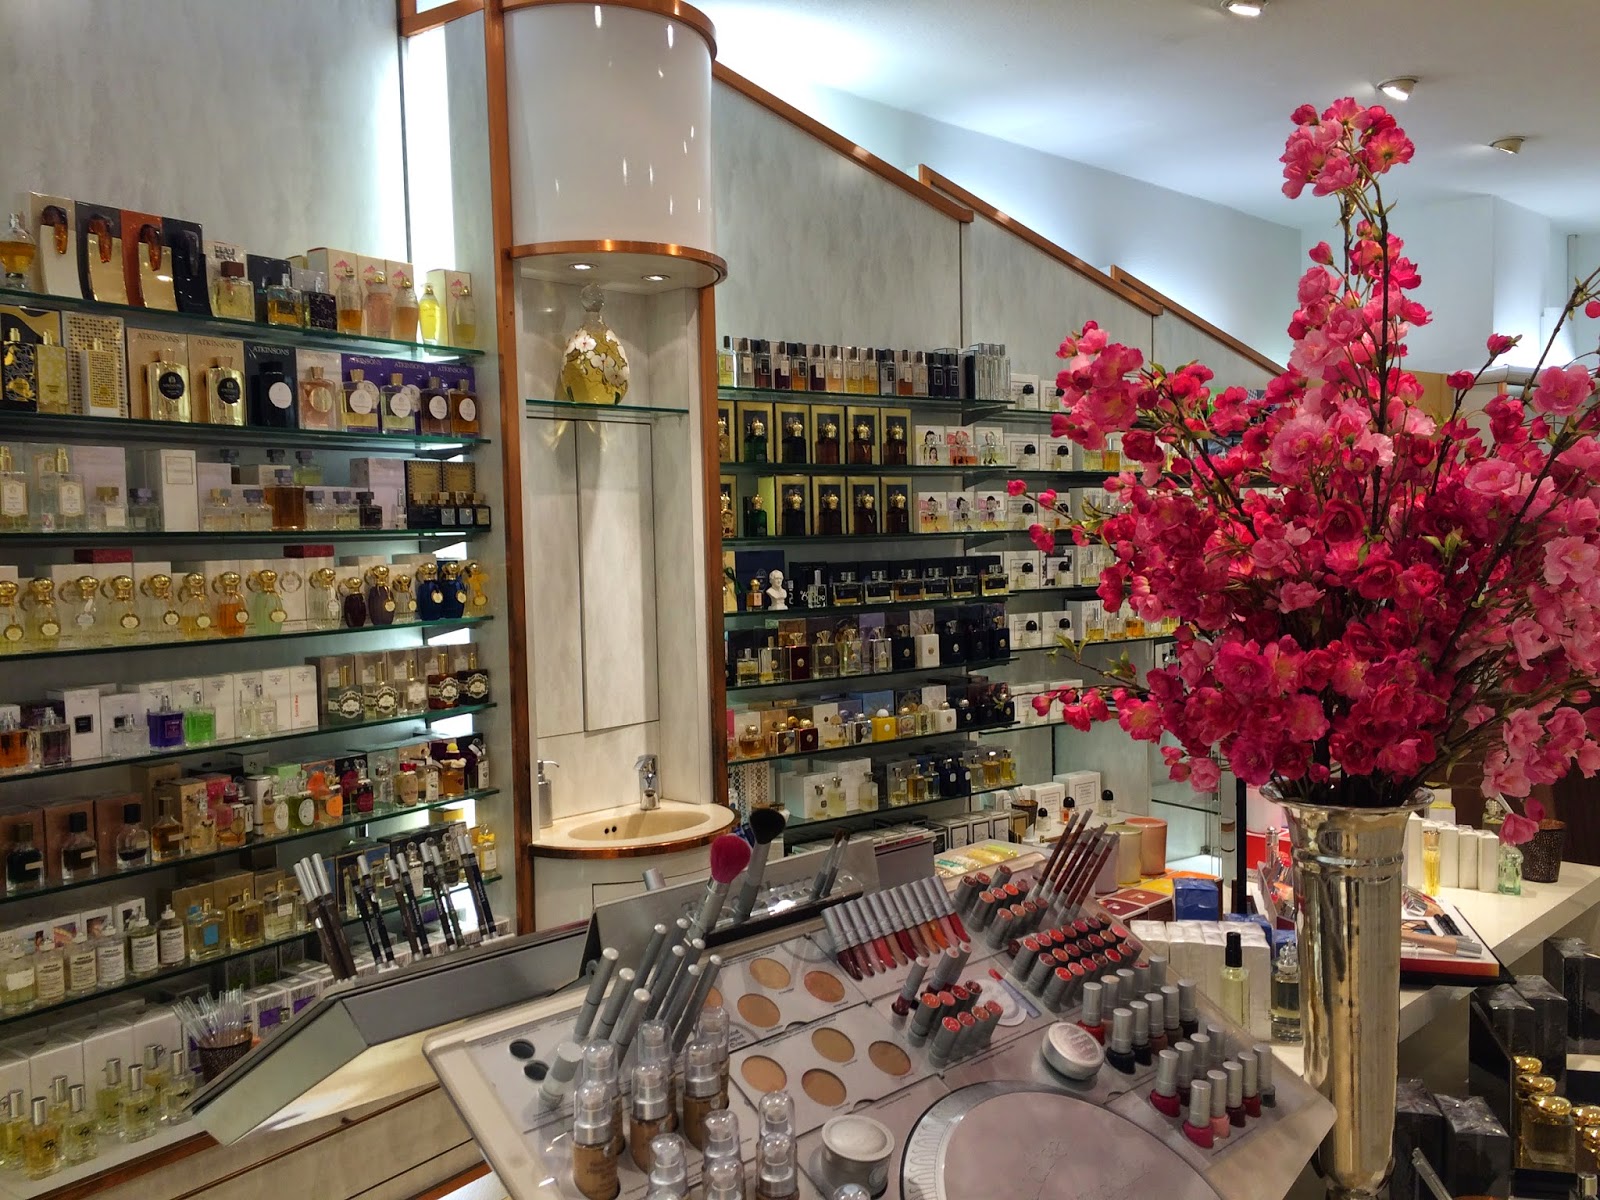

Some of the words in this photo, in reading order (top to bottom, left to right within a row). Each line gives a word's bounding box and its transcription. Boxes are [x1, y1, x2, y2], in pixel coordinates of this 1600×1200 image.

[137, 332, 179, 343] ATKINSONS
[197, 339, 237, 349] ATKINSONS
[252, 345, 290, 356] ATKINSONS
[348, 356, 382, 366] ATKINSONS
[394, 361, 426, 371] ATKINSONS
[437, 365, 469, 375] ATKINSONS
[862, 444, 870, 453] V
[899, 446, 905, 454] L
[868, 515, 875, 523] V
